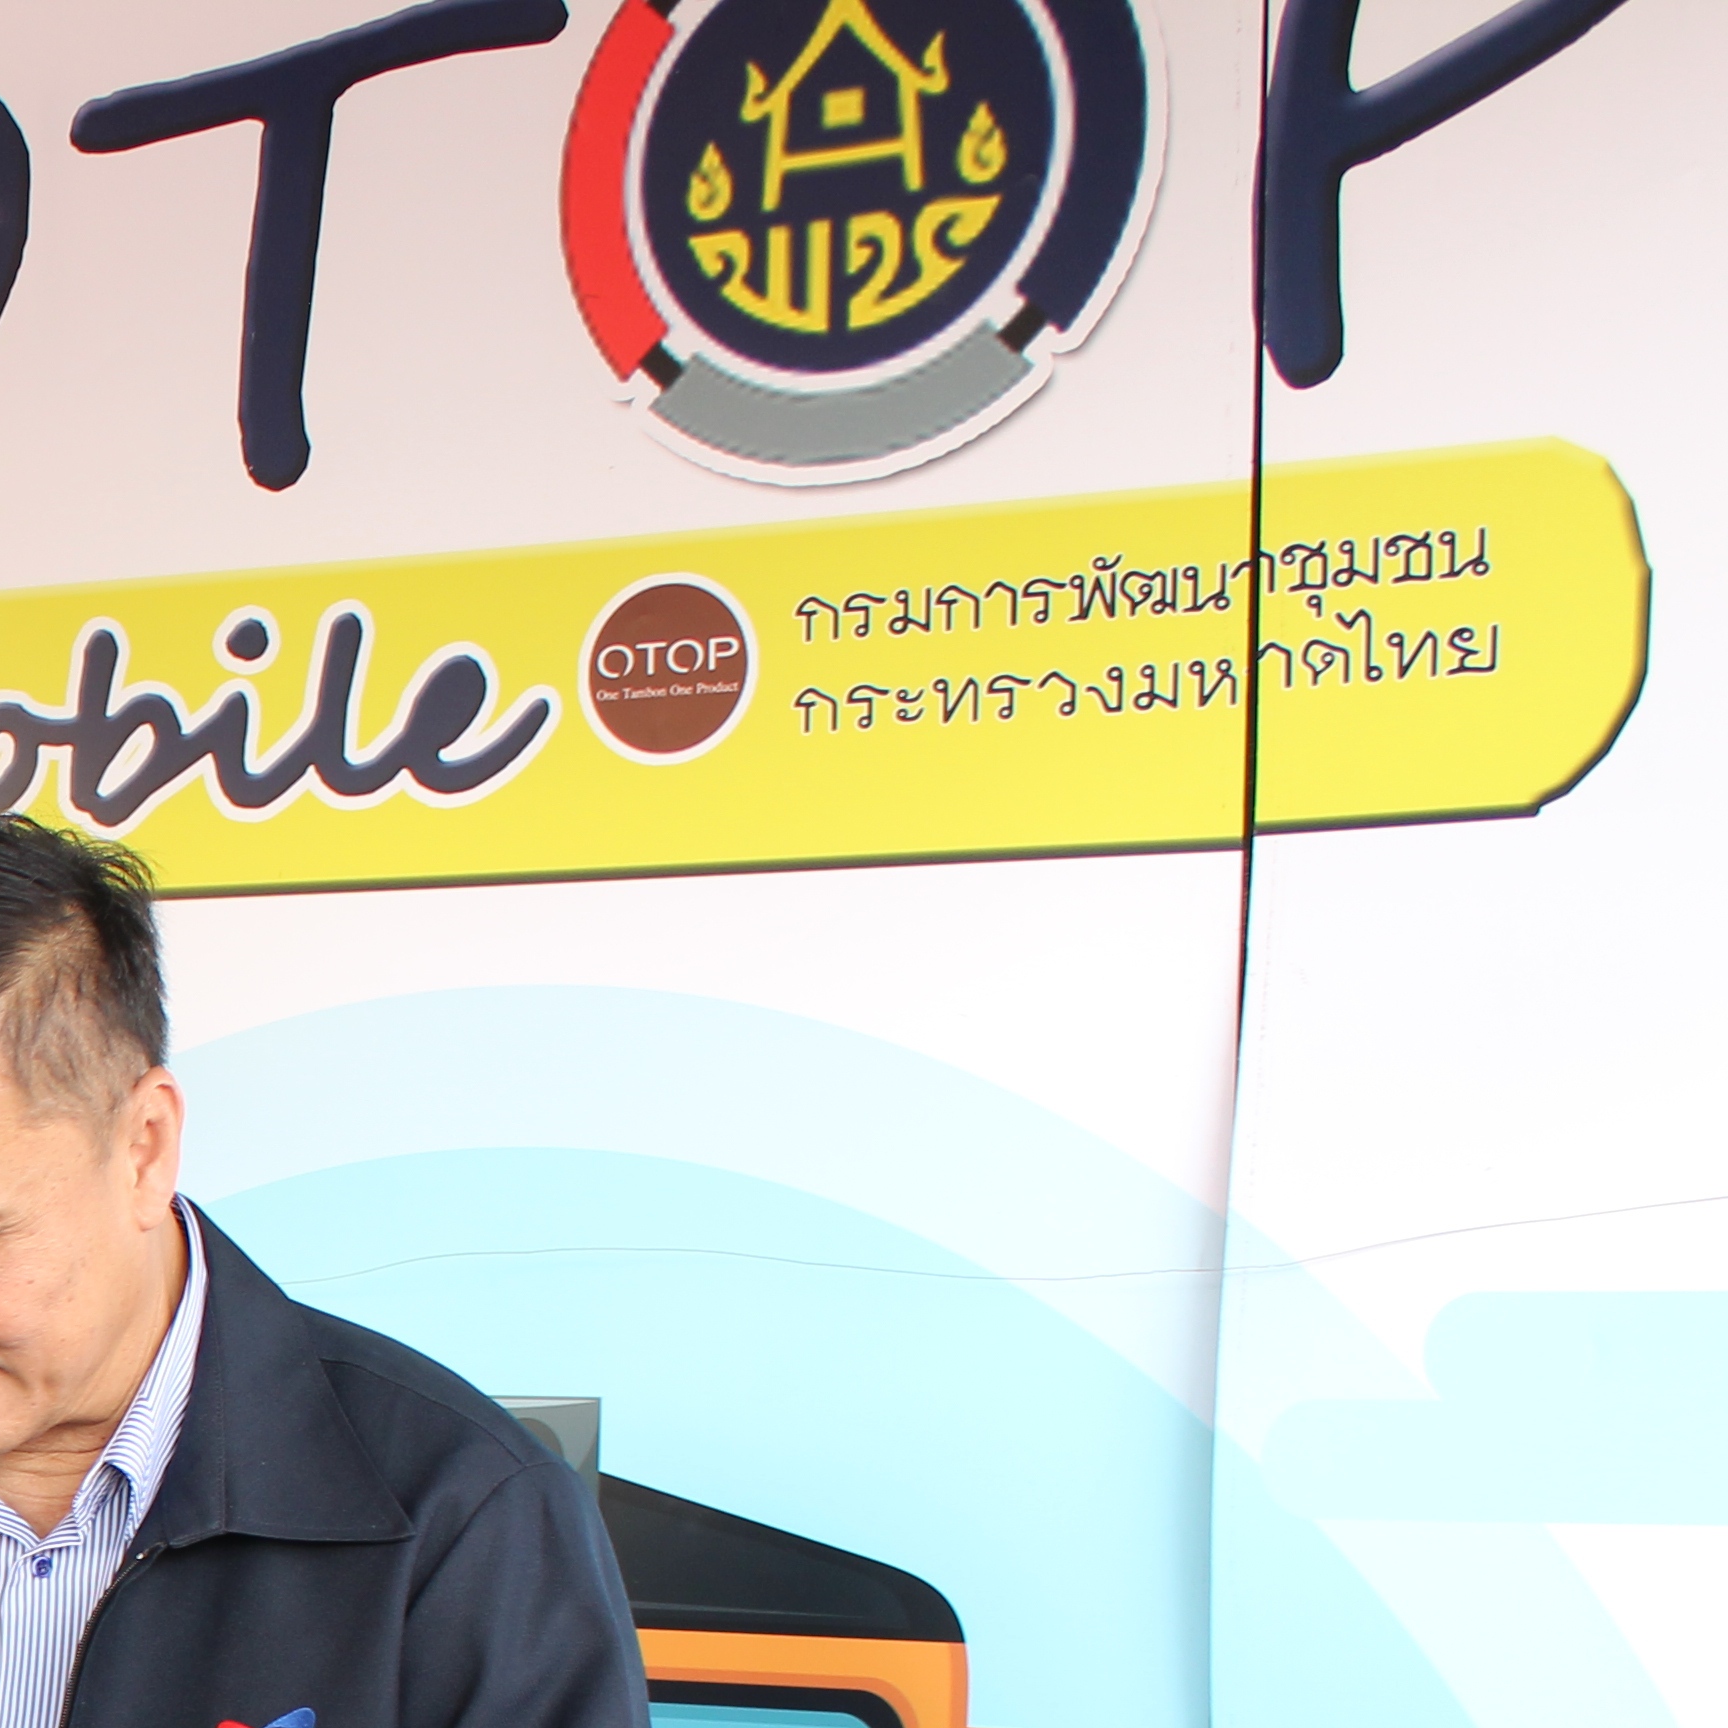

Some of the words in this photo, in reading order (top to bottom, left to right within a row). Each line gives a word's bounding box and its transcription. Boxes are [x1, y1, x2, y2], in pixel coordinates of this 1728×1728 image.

[795, 526, 1491, 642] กรมการพัฒนาชุมชน
[596, 635, 741, 680] OTOP
[597, 688, 619, 701] One
[623, 684, 666, 700] Tambon
[670, 683, 693, 696] One
[696, 680, 739, 695] Product
[794, 608, 1500, 734] กระทรวงมหาดไทย
